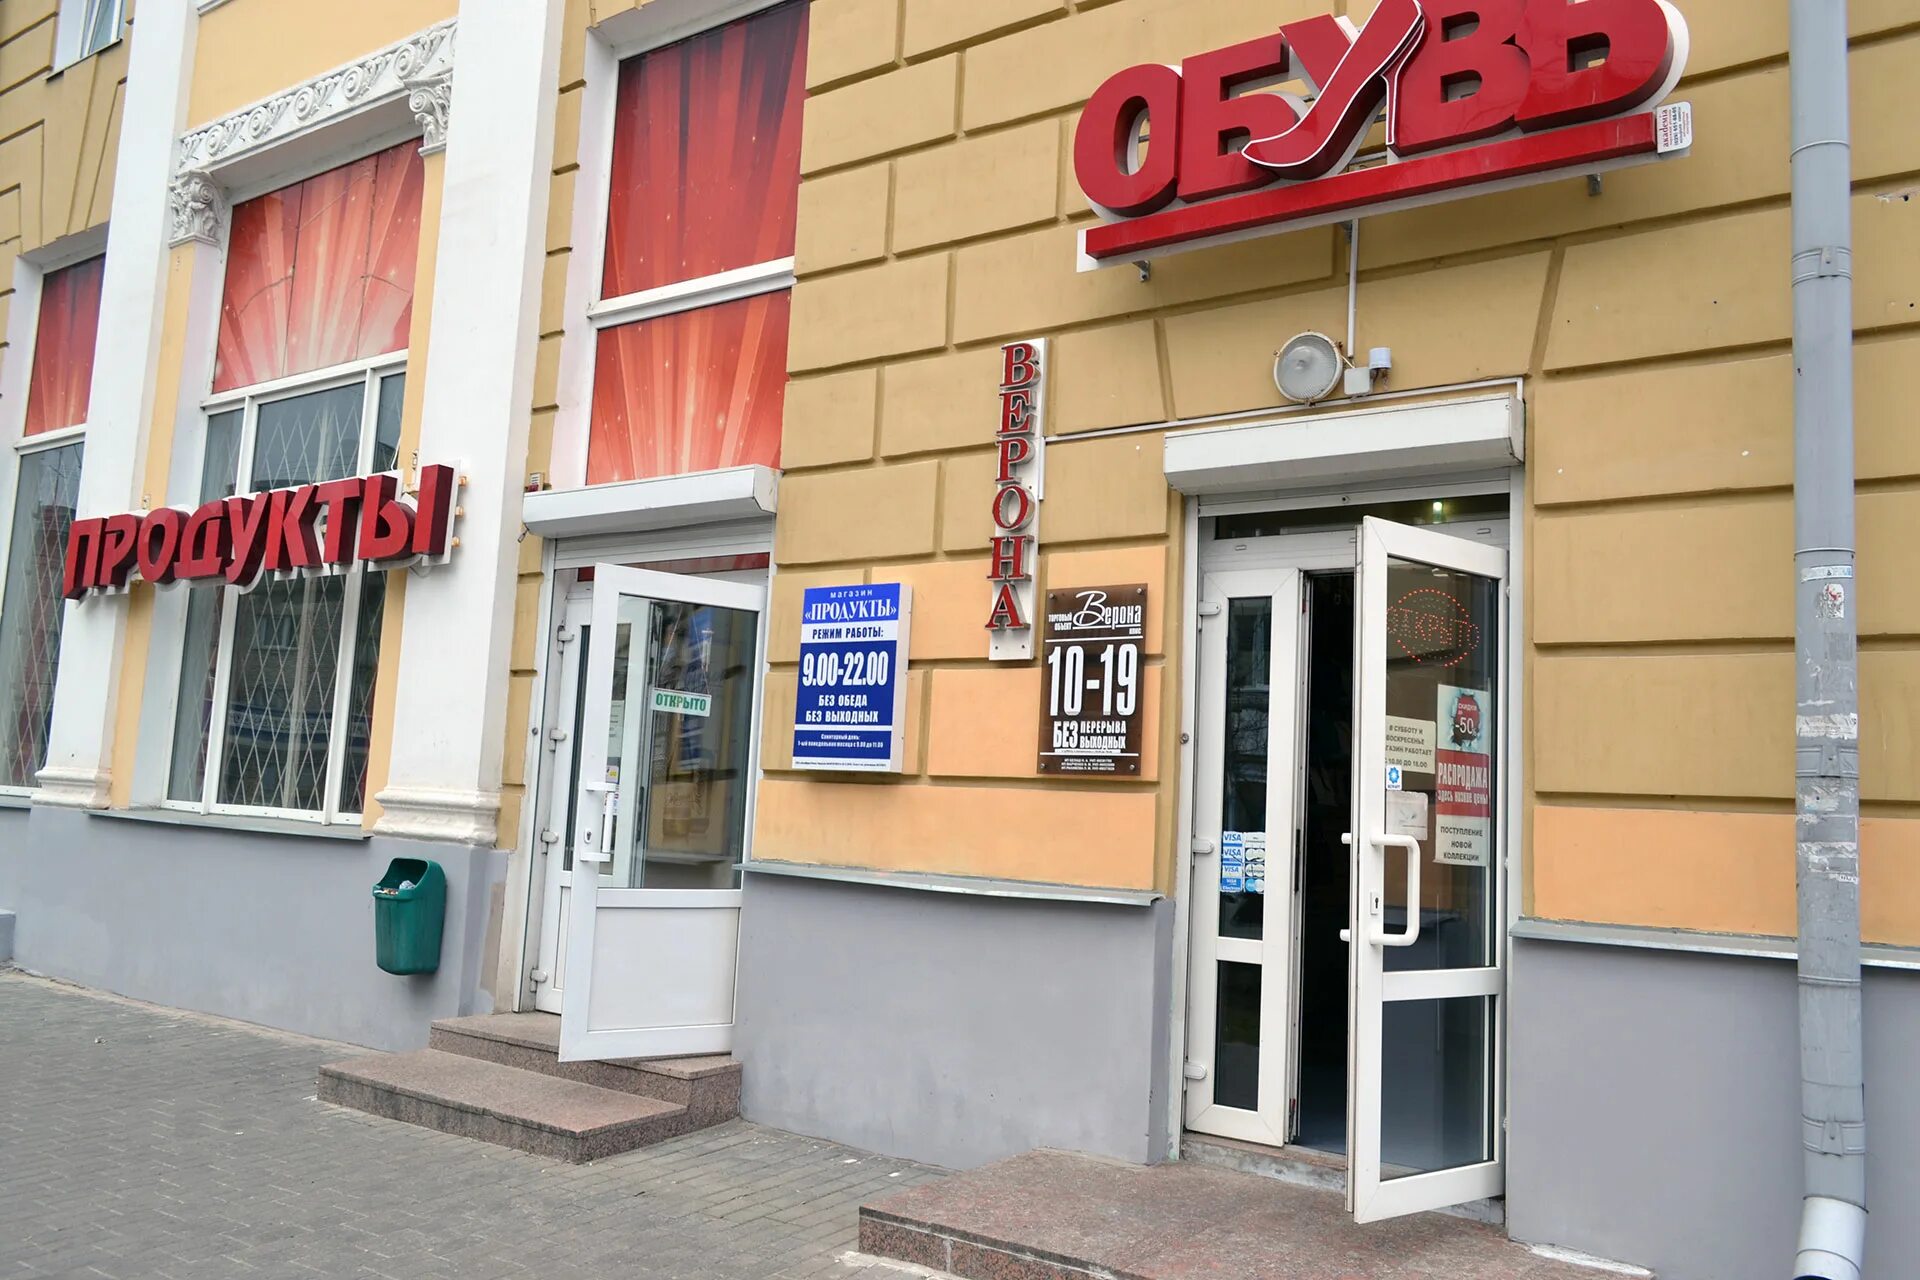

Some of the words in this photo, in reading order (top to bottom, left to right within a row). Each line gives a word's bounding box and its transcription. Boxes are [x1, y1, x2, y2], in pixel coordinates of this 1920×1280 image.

[1073, 0, 1678, 216] ОБУВЬ
[985, 342, 1038, 631] ВЕРОНА
[63, 464, 454, 600] ПРОДУКТЫ
[830, 589, 873, 599] магазин
[804, 598, 897, 622] «ПРОДУКТЫ»
[1073, 590, 1142, 630] Верона
[812, 628, 842, 640] РЕЖИМ
[845, 626, 884, 639] РАБОТЫ:
[802, 651, 889, 687] 9.00-22.00
[1048, 643, 1138, 716] 10-19
[655, 692, 707, 712] ОТКРЫТО
[818, 694, 835, 707] БЕЗ
[838, 694, 868, 708] ОБЕДА
[805, 710, 823, 723] БЕЗ
[825, 710, 879, 724] ВЫХОДНЫХ
[1053, 721, 1079, 748] БЕЗ
[1080, 720, 1127, 734] ПЕРЕРЫВА
[1394, 725, 1417, 734] СУББОТУ
[1079, 735, 1126, 750] ВЫХОДНЫХ
[1405, 747, 1432, 756] РАБОТАЕТ
[1438, 763, 1487, 790] РАСПРОДАЖА
[1440, 826, 1483, 836] ПОСТУПЛЕНИЕ
[1451, 840, 1472, 849] НОВОЙ
[1443, 852, 1479, 861] КОЛЛЕКЦИИ
